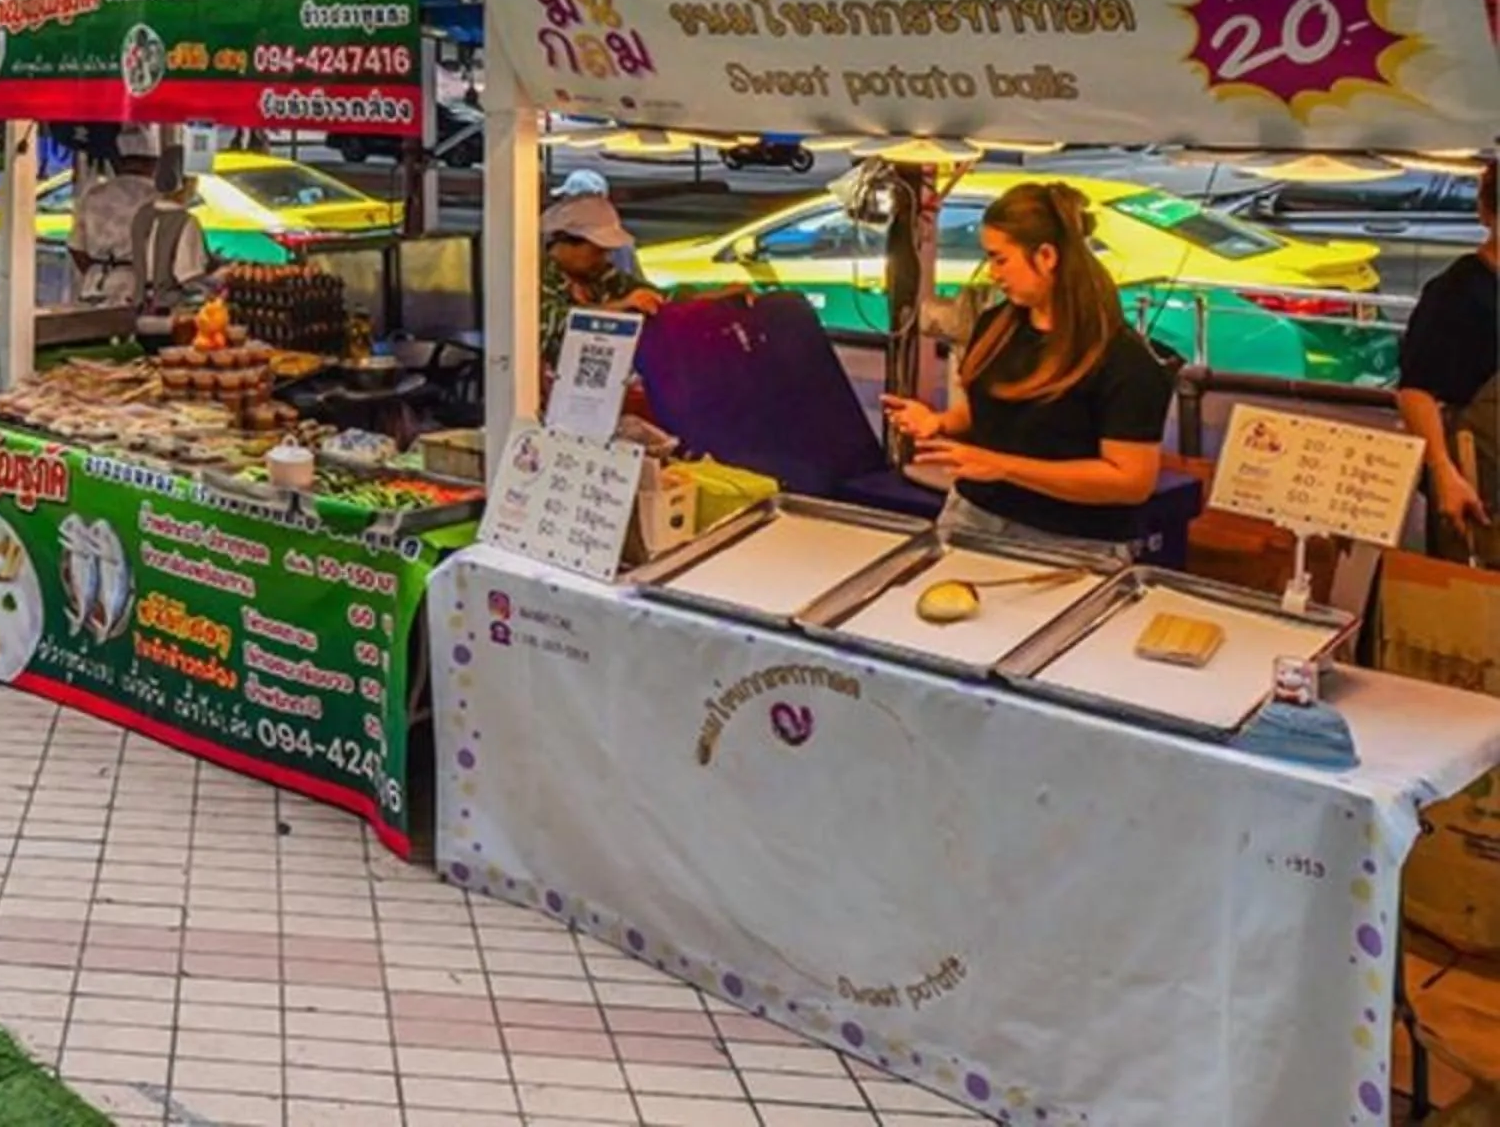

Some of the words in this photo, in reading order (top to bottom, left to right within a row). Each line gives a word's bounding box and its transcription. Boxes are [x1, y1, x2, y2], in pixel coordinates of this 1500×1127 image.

[253, 45, 412, 74] 094-4247416
[537, 27, 657, 78] กลม
[725, 60, 831, 95] Sweet
[843, 63, 977, 106] potato
[984, 63, 1081, 102] balls
